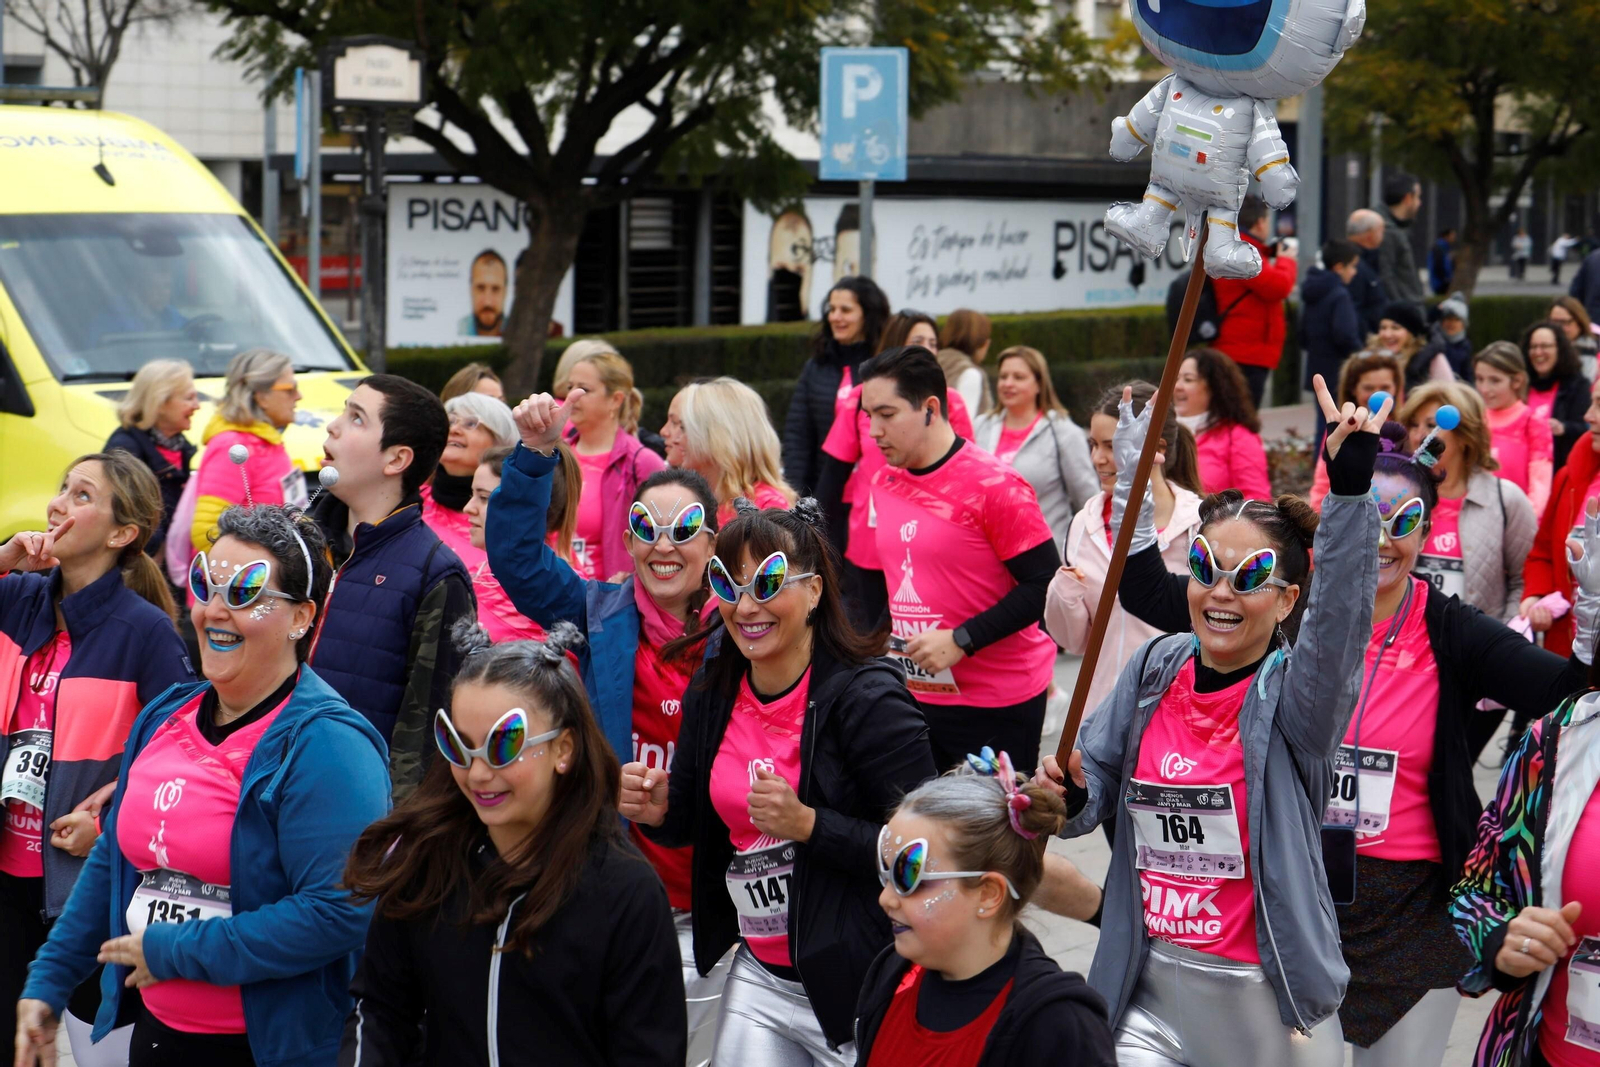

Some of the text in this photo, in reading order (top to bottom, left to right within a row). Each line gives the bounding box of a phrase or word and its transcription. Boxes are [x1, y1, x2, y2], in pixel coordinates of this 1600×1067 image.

[842, 64, 883, 118] P
[1053, 219, 1187, 271] PISAO
[16, 750, 49, 778] 39
[1156, 813, 1205, 845] 764
[744, 873, 792, 909] 1147
[1140, 877, 1223, 919] PINK
